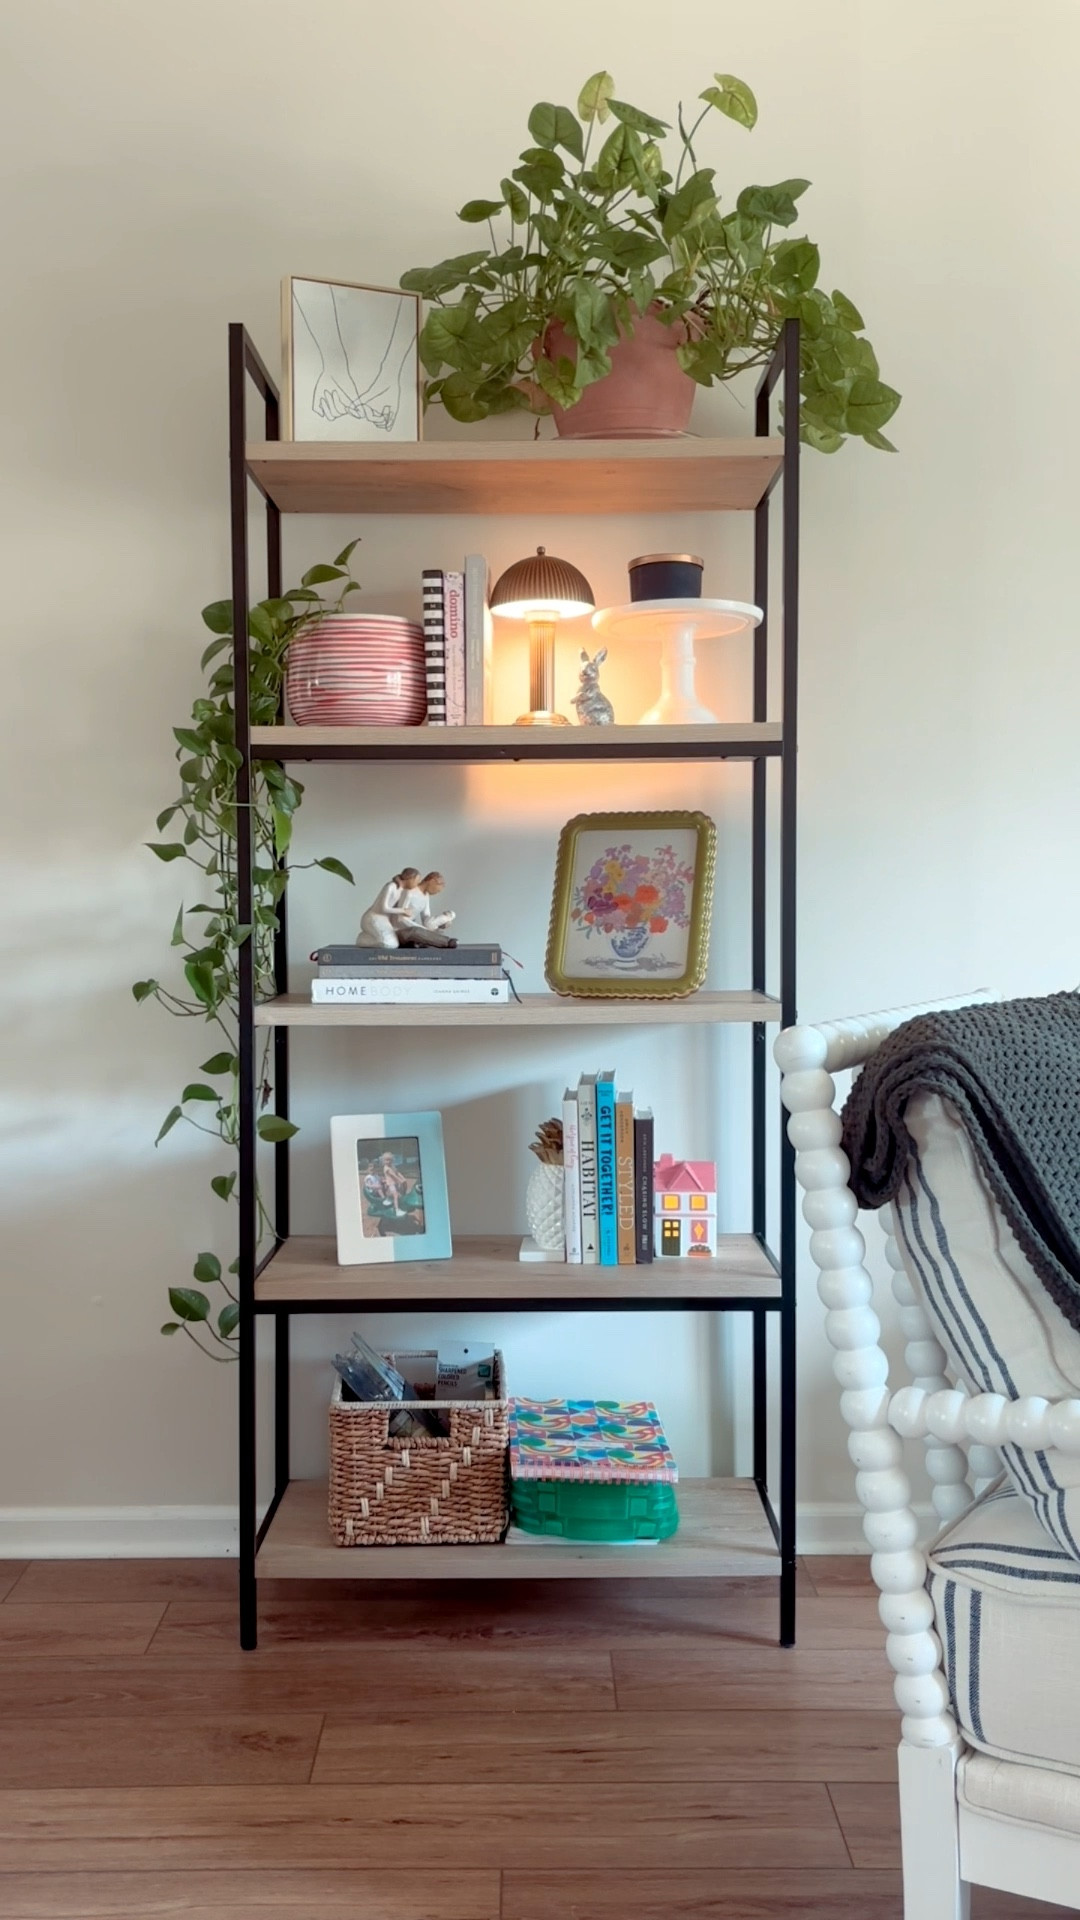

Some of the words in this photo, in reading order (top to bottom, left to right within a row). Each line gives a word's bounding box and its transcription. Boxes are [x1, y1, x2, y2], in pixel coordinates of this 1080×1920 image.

[449, 589, 460, 639] domino
[600, 1105, 612, 1128] GET
[600, 1133, 613, 1145] IT
[582, 1141, 596, 1220] HABITAT
[601, 1149, 613, 1216] TOGETHER!
[619, 1156, 634, 1231] STYLED
[439, 1367, 467, 1375] SHARPENED
